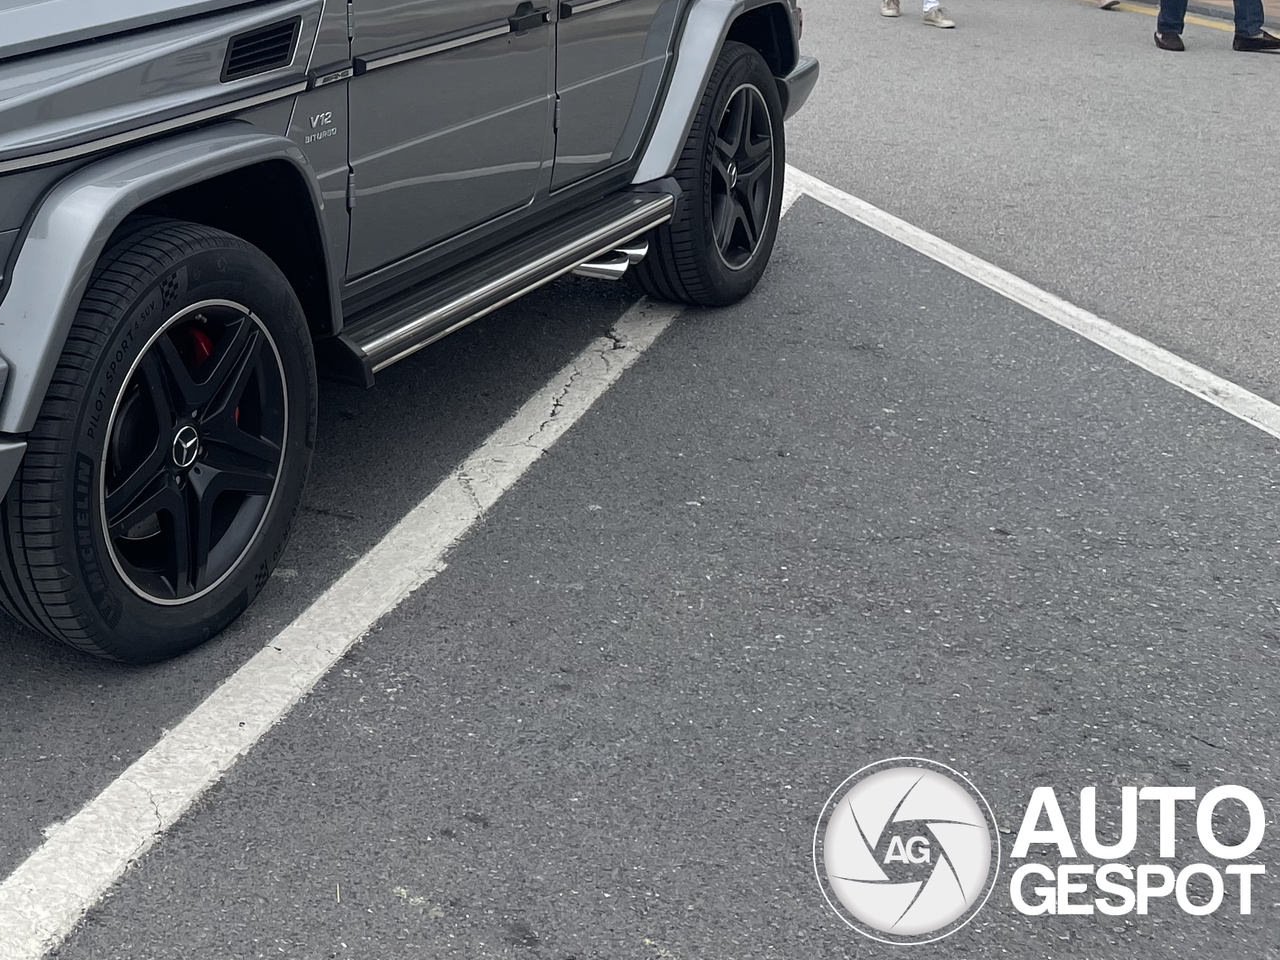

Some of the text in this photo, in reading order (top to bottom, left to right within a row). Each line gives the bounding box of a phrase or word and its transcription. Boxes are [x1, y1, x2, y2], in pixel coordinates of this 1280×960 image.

[304, 127, 337, 144] BITURBO
[309, 111, 332, 128] V12
[87, 300, 156, 440] PILOT SPORT 4 SUV
[76, 460, 106, 595] MICHELIN
